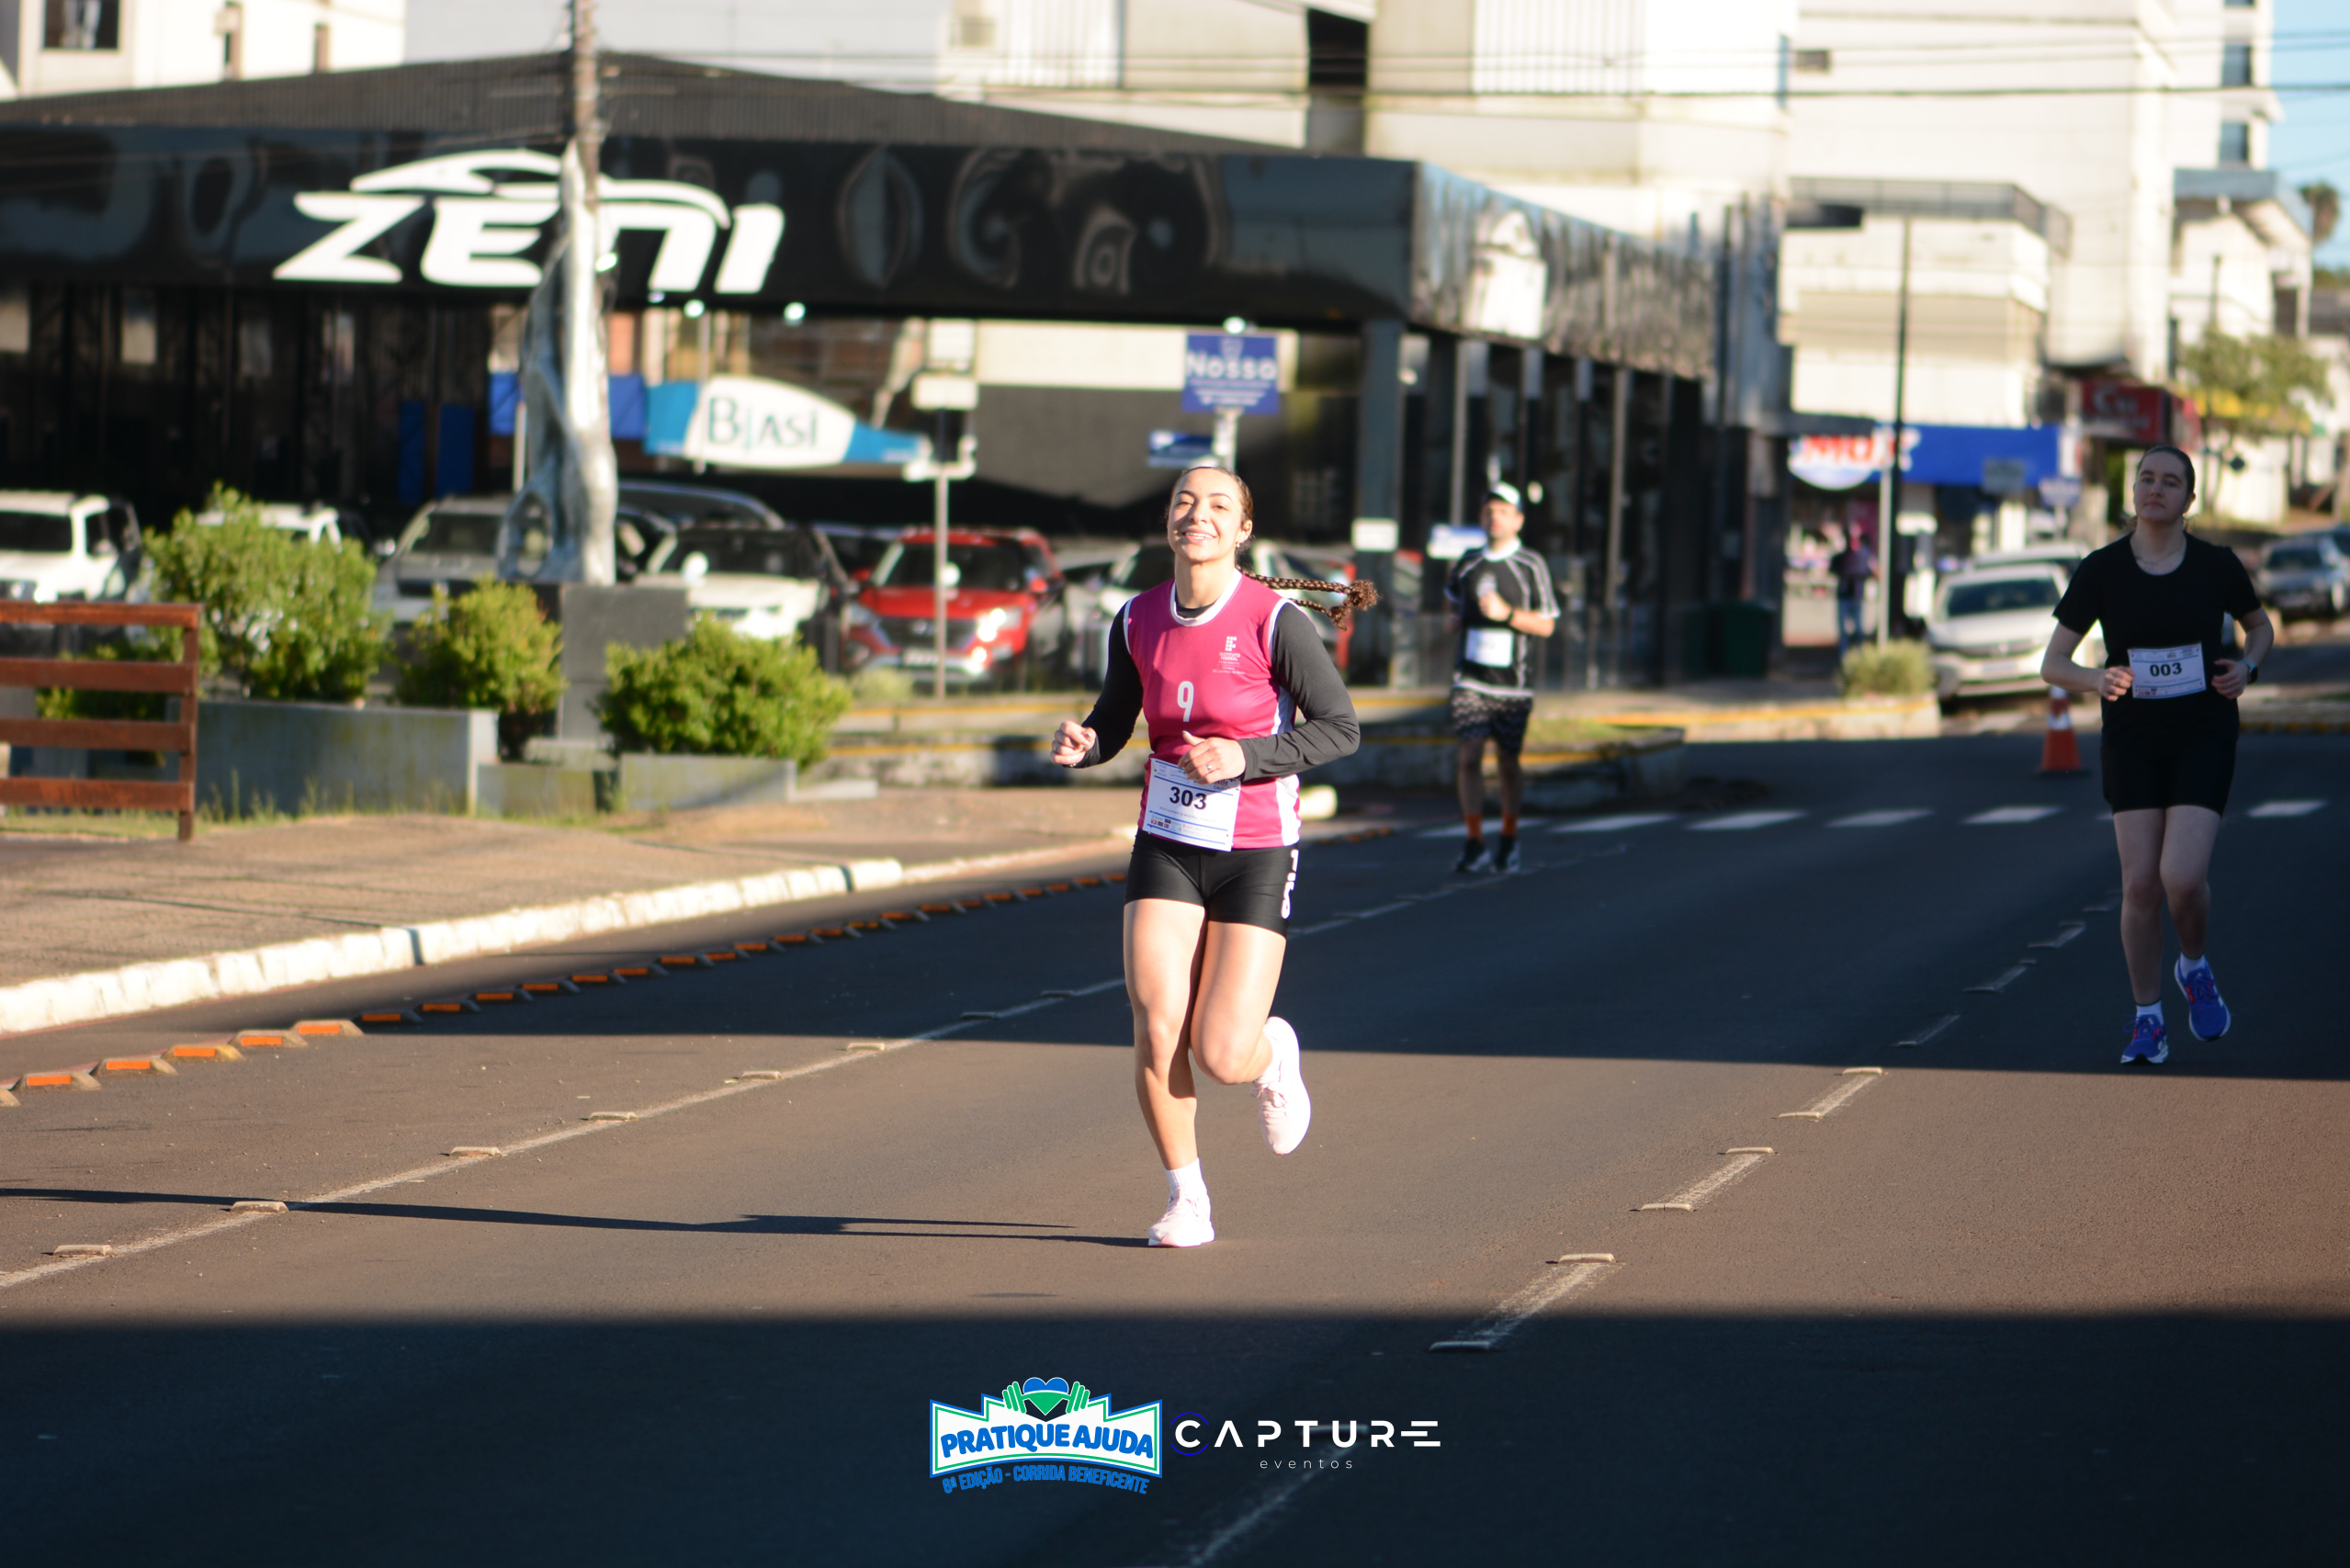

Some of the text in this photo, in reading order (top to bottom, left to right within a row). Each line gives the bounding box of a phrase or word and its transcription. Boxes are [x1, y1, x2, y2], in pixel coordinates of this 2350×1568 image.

[2150, 662, 2182, 677] 003
[1177, 681, 1194, 722] 9
[1169, 786, 1207, 810] 303
